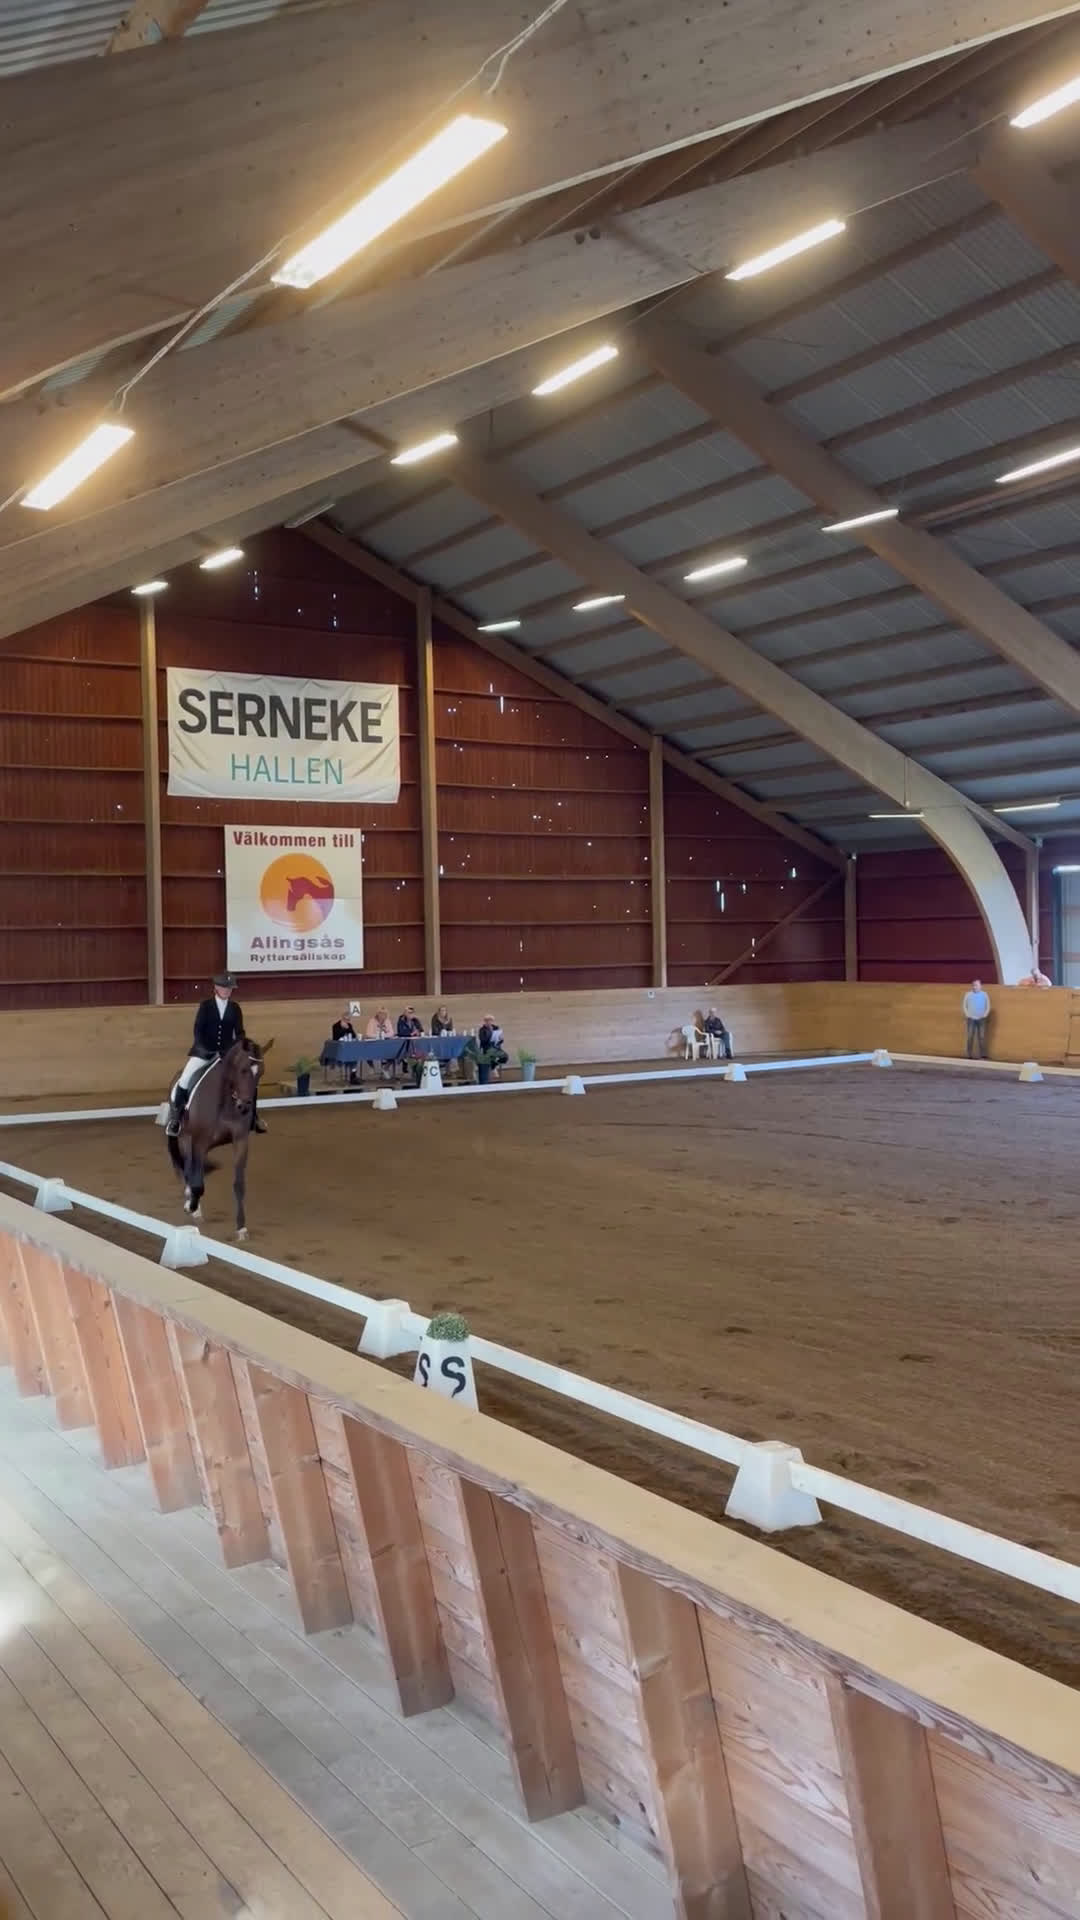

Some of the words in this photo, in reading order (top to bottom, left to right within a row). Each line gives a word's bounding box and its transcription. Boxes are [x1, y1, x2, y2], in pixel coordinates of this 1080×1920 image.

[178, 688, 383, 744] SERNEKE
[231, 753, 343, 785] HALLEN
[233, 831, 326, 848] Välkommen
[332, 833, 354, 848] till
[250, 935, 345, 951] Alingsås
[250, 952, 346, 963] Ryttarsällskap
[352, 1005, 360, 1014] A
[429, 1066, 438, 1077] C
[441, 1356, 466, 1398] S
